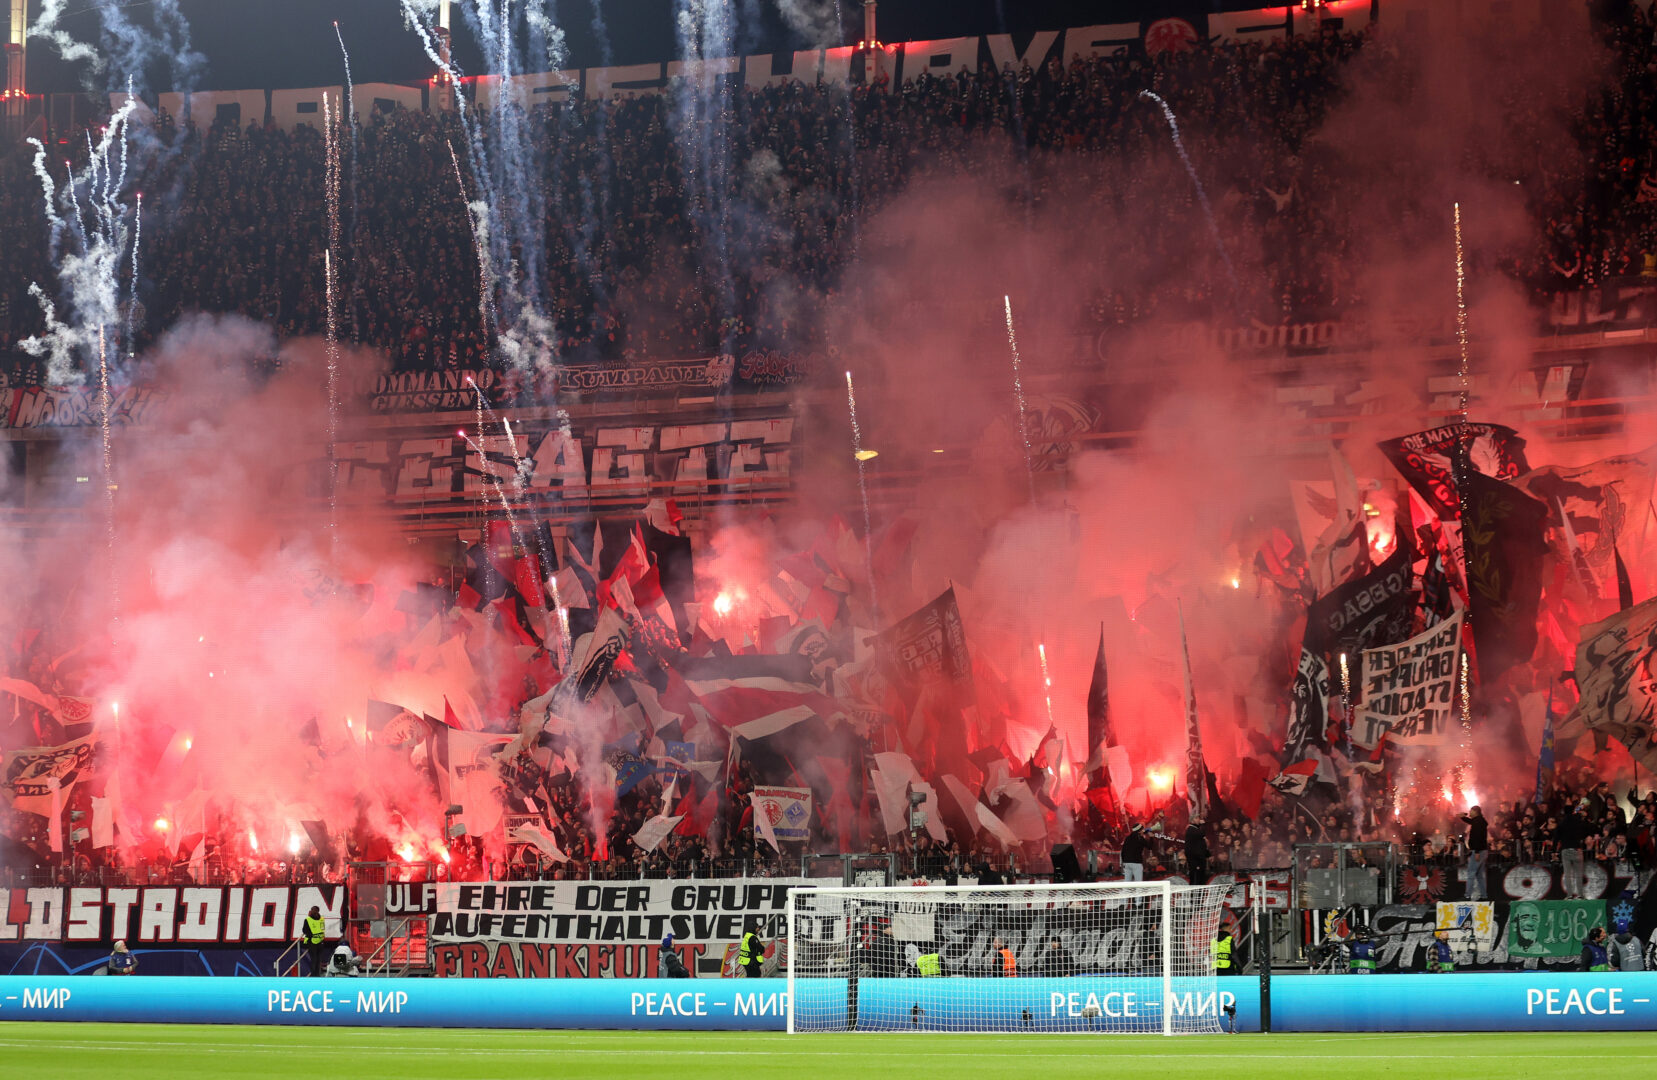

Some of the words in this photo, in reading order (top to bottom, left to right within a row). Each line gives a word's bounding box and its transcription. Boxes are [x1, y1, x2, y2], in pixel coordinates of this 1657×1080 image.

[367, 368, 494, 394] OMMANDO
[558, 365, 706, 388] KUMPANE
[386, 883, 435, 912] ULF
[457, 885, 555, 911] EHRE
[575, 885, 650, 911] DER
[671, 885, 817, 911] GRUPPE
[431, 912, 841, 939] AUFENTHALTSVERBOT
[22, 987, 72, 1009] МИР
[267, 990, 333, 1013] PEACE
[356, 990, 408, 1014] МИР
[630, 991, 708, 1016] PEACE
[1050, 992, 1138, 1017] PEACE
[1526, 987, 1625, 1015] PEACE
